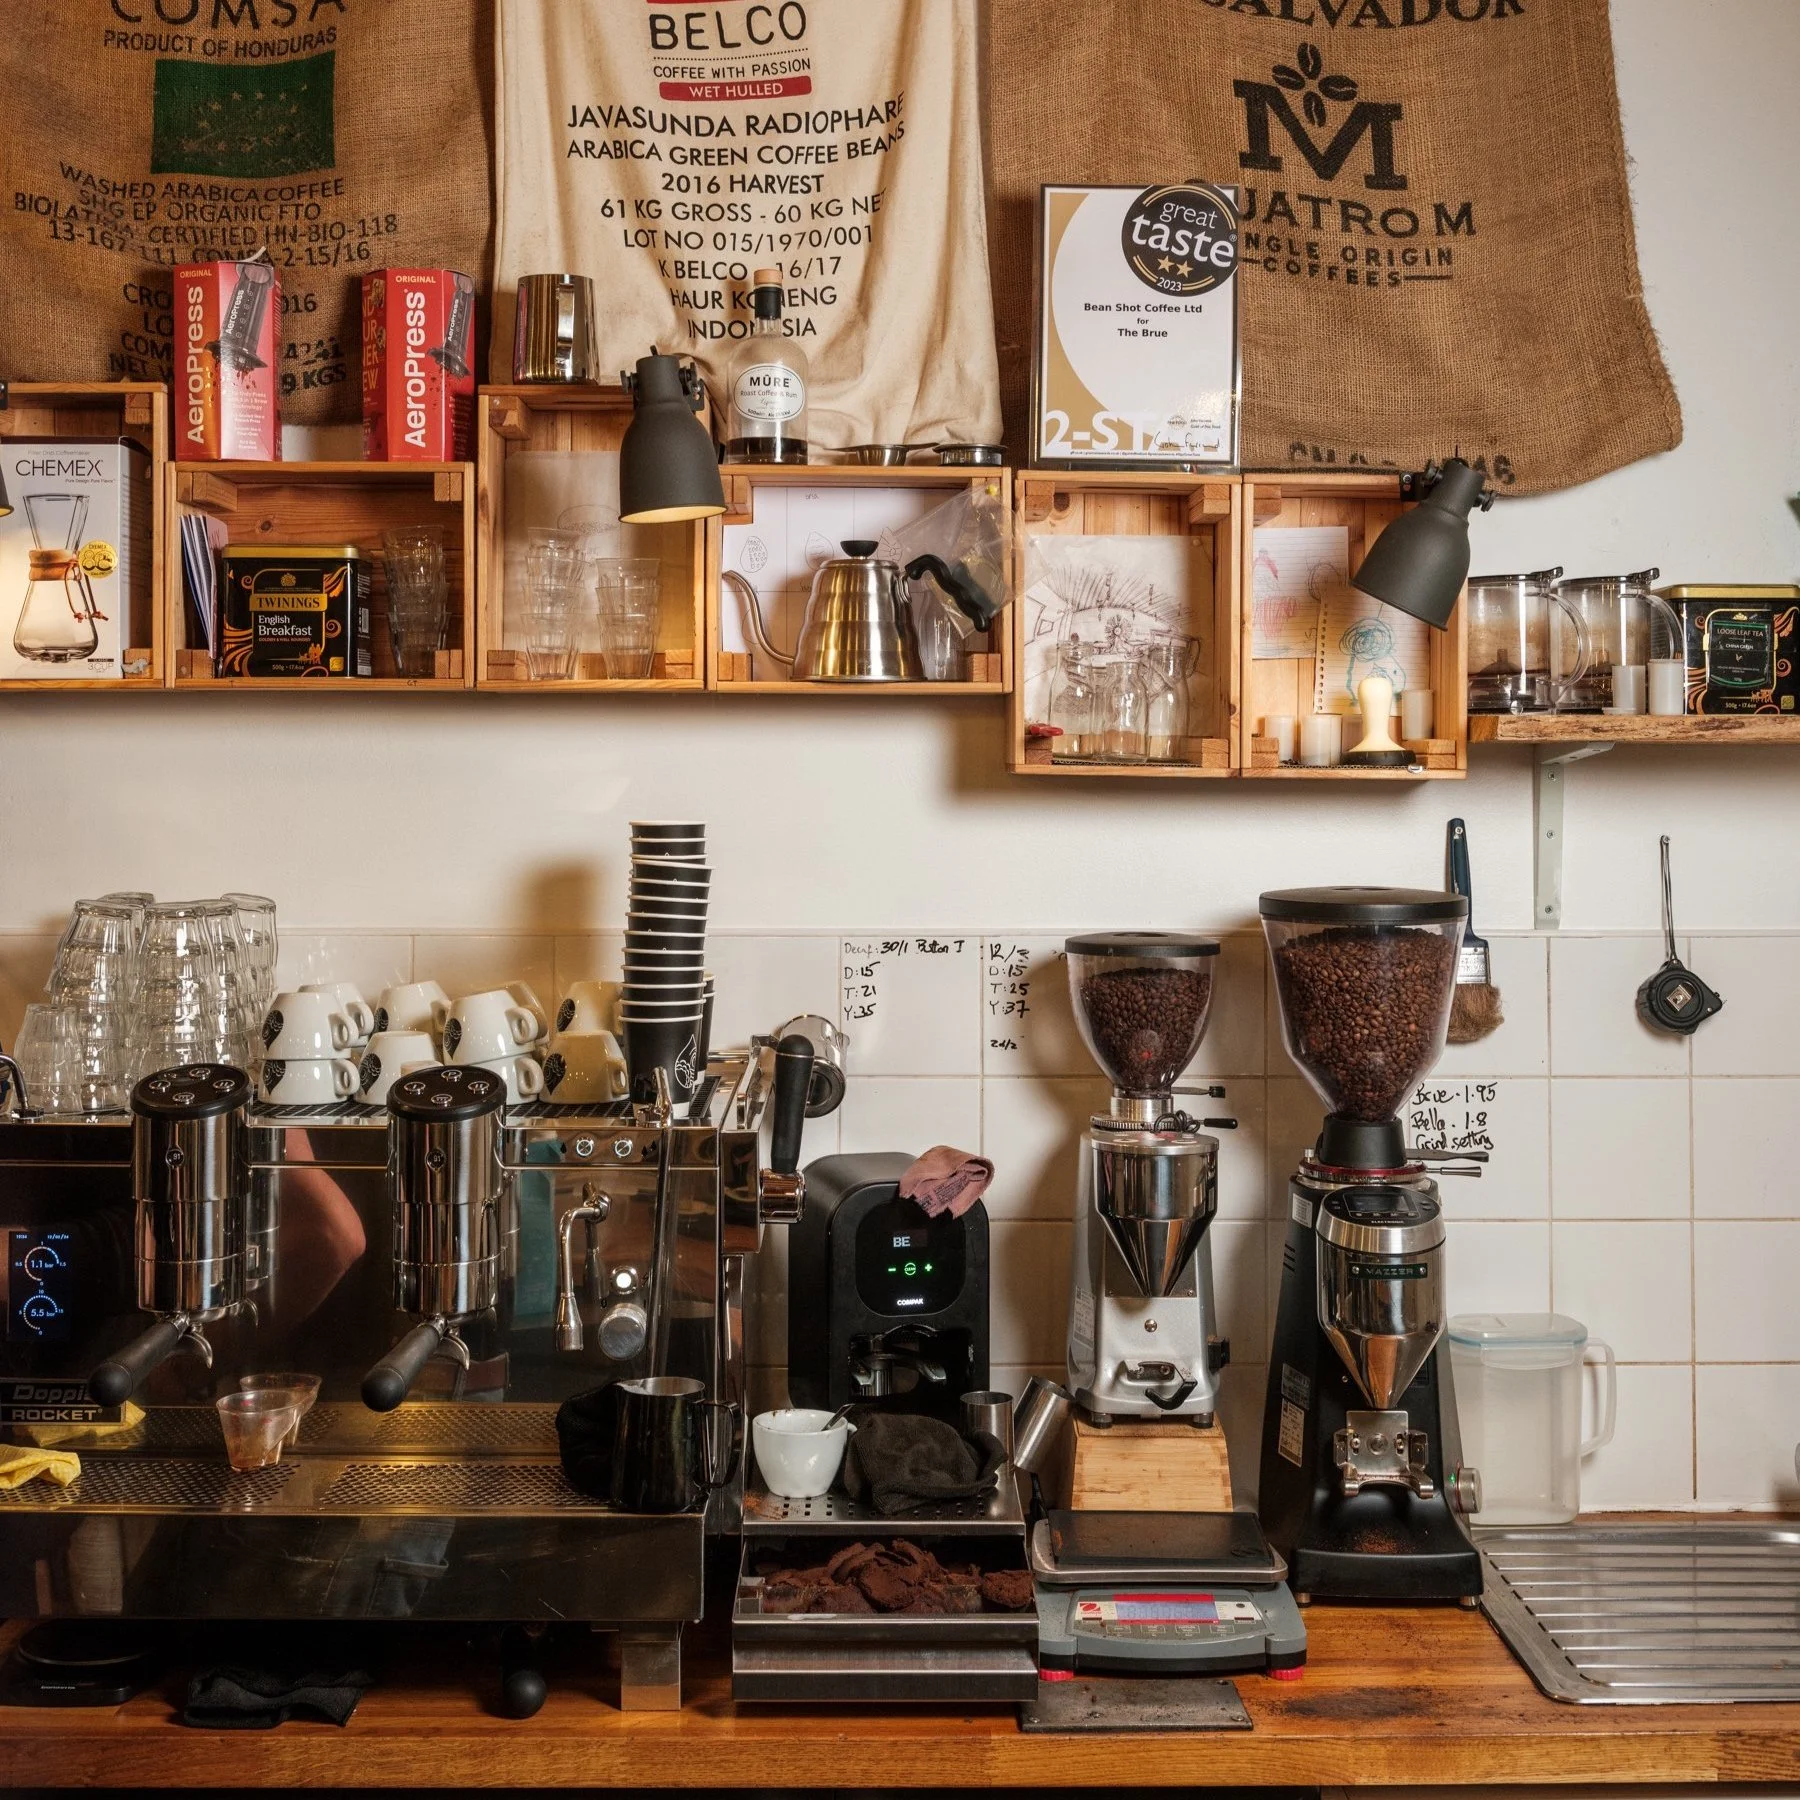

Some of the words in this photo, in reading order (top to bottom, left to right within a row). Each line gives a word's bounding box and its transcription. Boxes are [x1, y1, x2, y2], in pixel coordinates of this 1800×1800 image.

[649, 1, 807, 50] BELCO
[104, 30, 197, 52] PRODUCT
[203, 39, 229, 57] OF
[236, 26, 338, 58] HONDURAS
[653, 65, 706, 79] COFFEE
[711, 66, 746, 79] WITH
[752, 58, 811, 76] PASSION
[689, 86, 720, 98] WET
[726, 83, 784, 97] HULLED
[567, 105, 737, 137] JAVASUNDA
[566, 139, 662, 161] ARABICA
[669, 146, 748, 167] GREEN
[756, 144, 839, 165] COFFEE
[846, 121, 905, 160] BEANS
[60, 161, 156, 200] WASHED
[162, 182, 260, 203] ARABICA
[264, 178, 345, 202] COFFEE
[661, 172, 721, 194] 2016
[729, 174, 825, 194] HARVEST
[133, 203, 157, 221] EP
[167, 202, 271, 223] ORGANIC
[279, 203, 321, 221] FTO
[600, 199, 626, 219] 61
[635, 200, 663, 219] KG
[671, 203, 752, 223] GROSS
[774, 205, 802, 223] 60
[810, 199, 844, 219] KG
[1160, 202, 1218, 229] great
[148, 225, 257, 247] CERTIFIED
[264, 214, 398, 245] HN-BIO-118
[623, 228, 657, 249] LOT
[664, 230, 704, 249] NO
[711, 224, 874, 255] 015/1970/001
[1131, 214, 1235, 269] taste
[1340, 246, 1453, 267] ORIGIN
[179, 269, 213, 279] ORIGINAL
[395, 276, 437, 284] ORIGINAL
[674, 260, 748, 282] BELCO
[1262, 257, 1401, 288] COFFEES
[1157, 277, 1183, 292] 2023
[670, 287, 725, 310] HAUR
[1084, 303, 1112, 313] Bean
[1115, 303, 1141, 313] Shot
[1144, 304, 1181, 313] Coffee
[1184, 304, 1203, 314] Ltd
[225, 289, 245, 336] AeroPress
[447, 298, 460, 343] AeroPress
[1118, 328, 1139, 338] The
[1142, 328, 1168, 338] Brue
[187, 285, 205, 445] AeroPress
[404, 291, 427, 449] AeroPress
[749, 374, 789, 388] MÛRE
[757, 388, 778, 396] Coffee
[15, 459, 102, 477] CHEMEX
[257, 597, 321, 609] TWININGS
[258, 615, 290, 625] English
[258, 625, 313, 636] Breakfast
[893, 1236, 911, 1248] BE
[31, 1260, 43, 1268] 1.1
[1365, 1267, 1414, 1276] MAZZER
[30, 1308, 45, 1317] 5.5
[12, 1384, 90, 1403] Doppi
[12, 1408, 97, 1421] ROCKET
